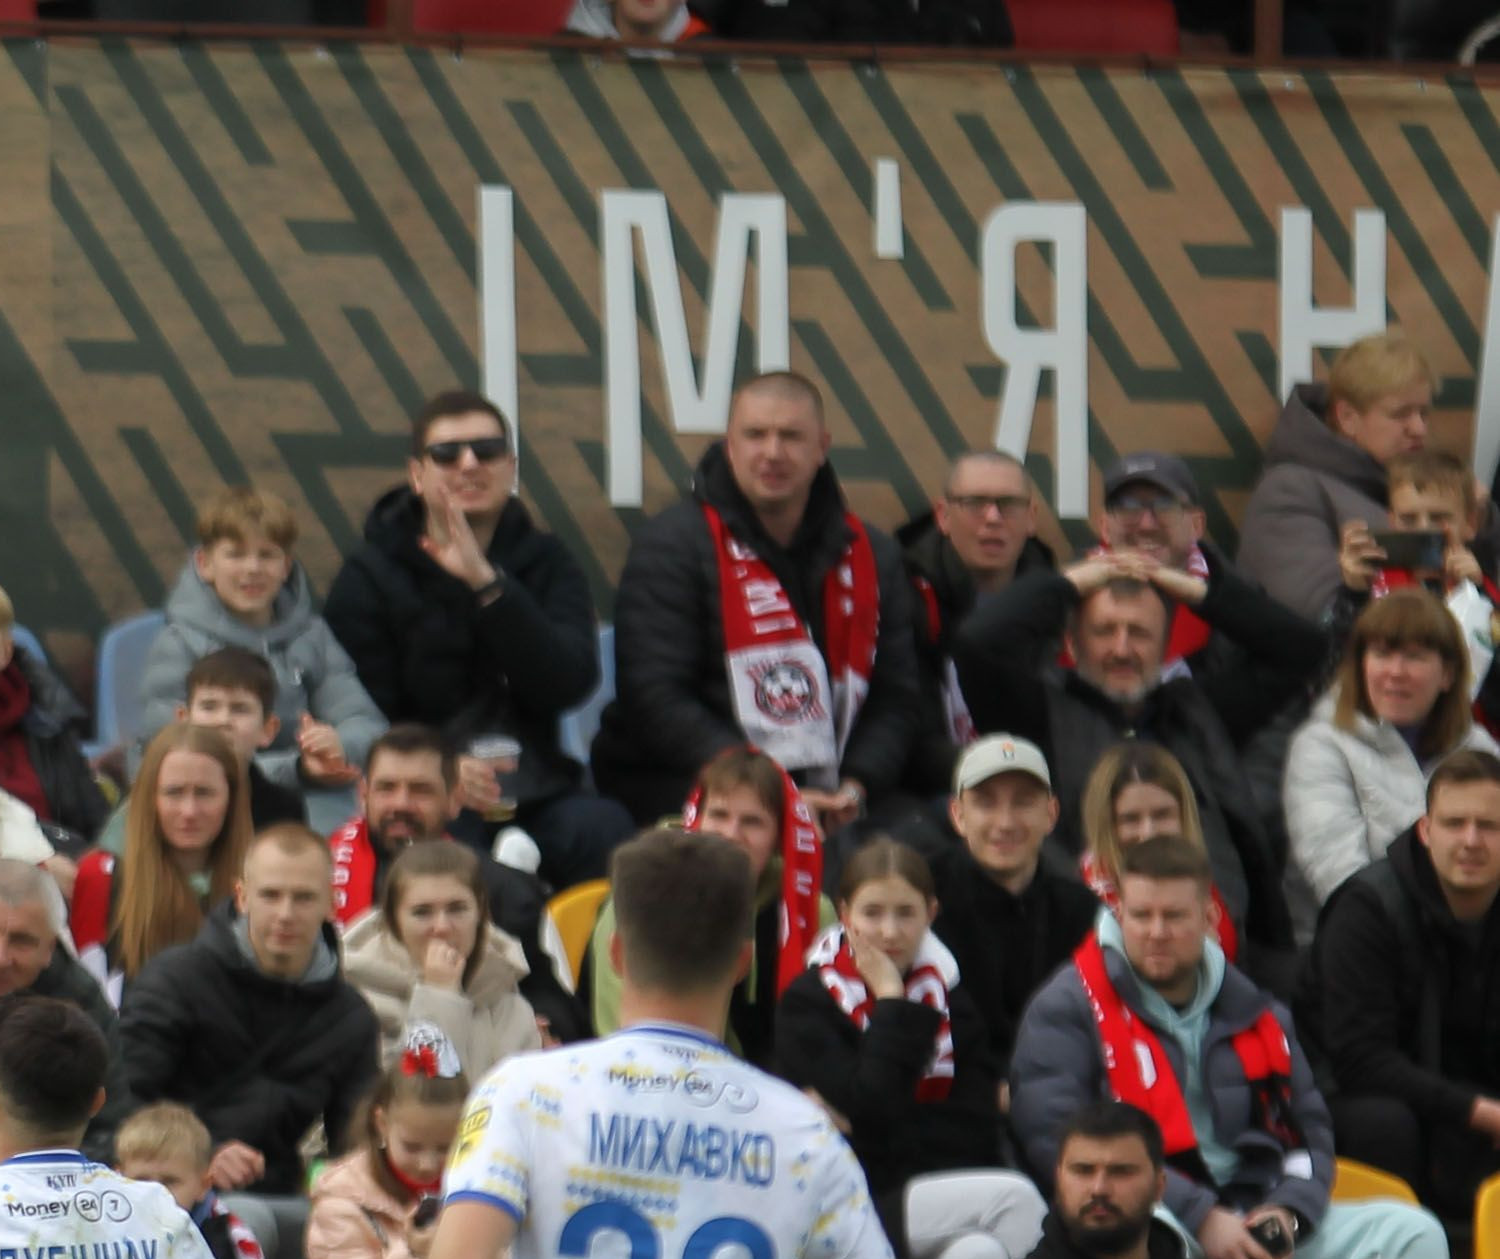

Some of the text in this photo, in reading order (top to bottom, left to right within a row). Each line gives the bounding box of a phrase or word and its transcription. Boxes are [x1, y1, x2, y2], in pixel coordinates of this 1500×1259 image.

[607, 1067, 681, 1092] Money
[588, 1111, 777, 1189] МИХАВКО
[7, 1198, 72, 1218] Money
